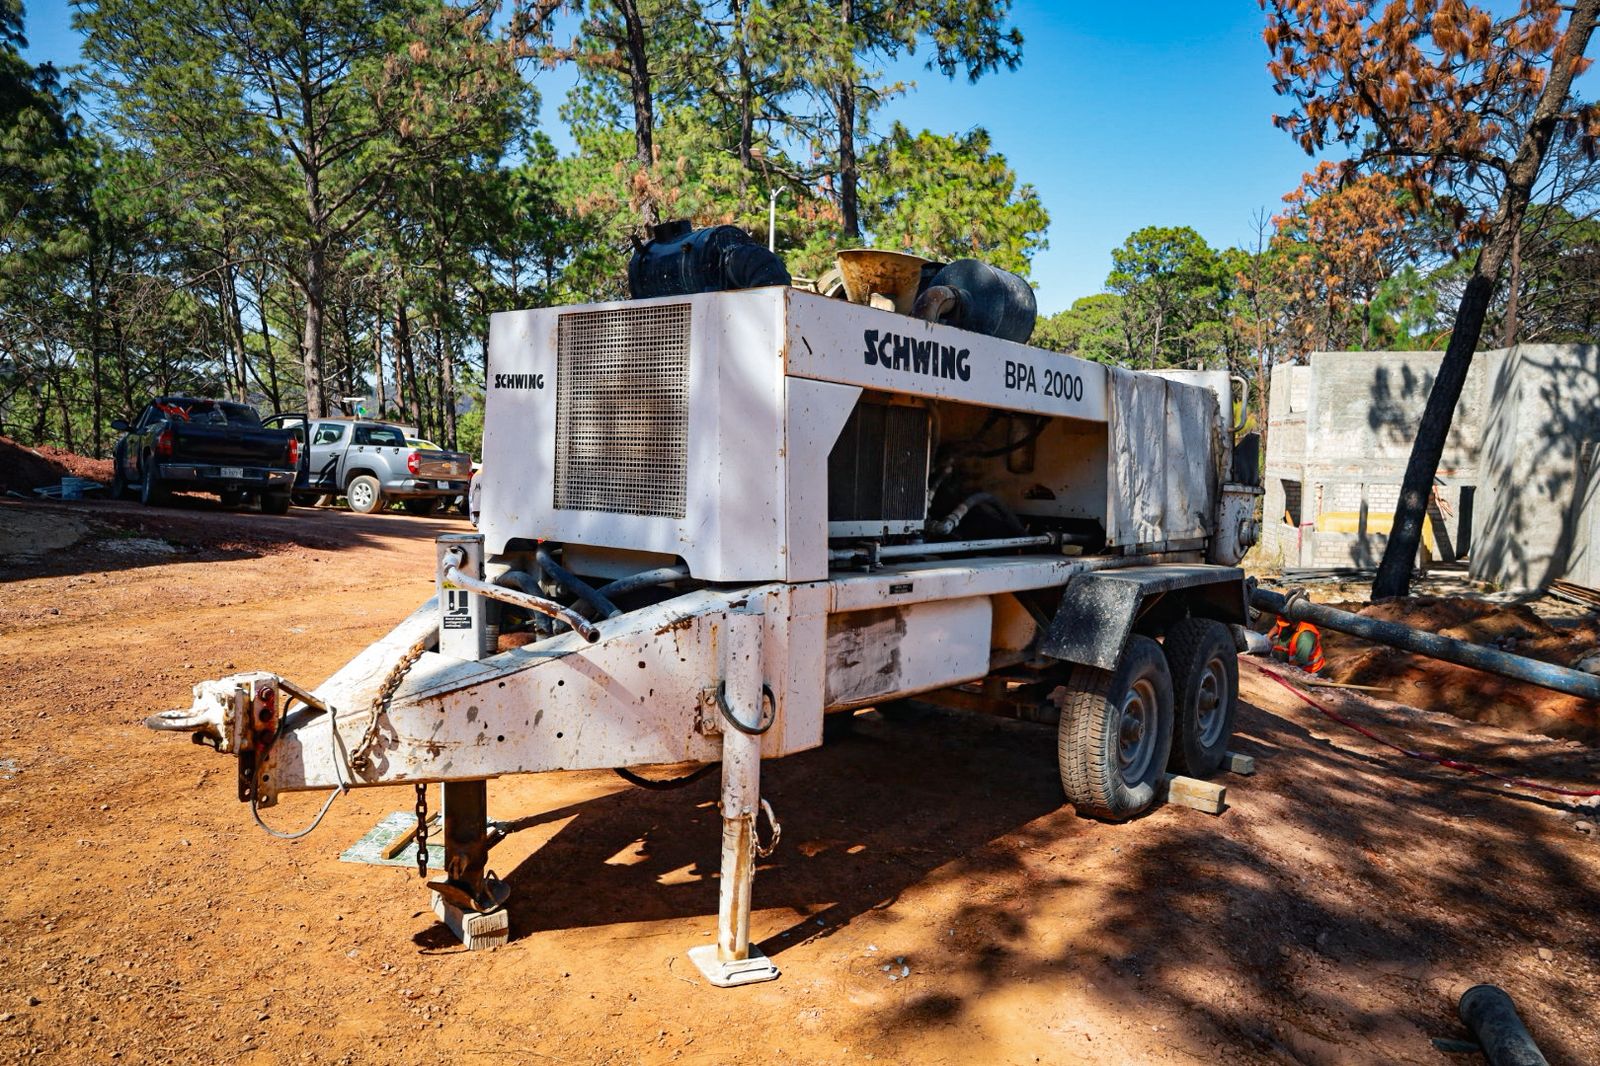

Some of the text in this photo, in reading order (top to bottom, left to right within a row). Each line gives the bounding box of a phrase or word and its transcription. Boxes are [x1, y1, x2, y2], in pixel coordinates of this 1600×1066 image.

[495, 374, 544, 389] SCHWING
[864, 329, 1083, 402] SCHWING BPA 2000
